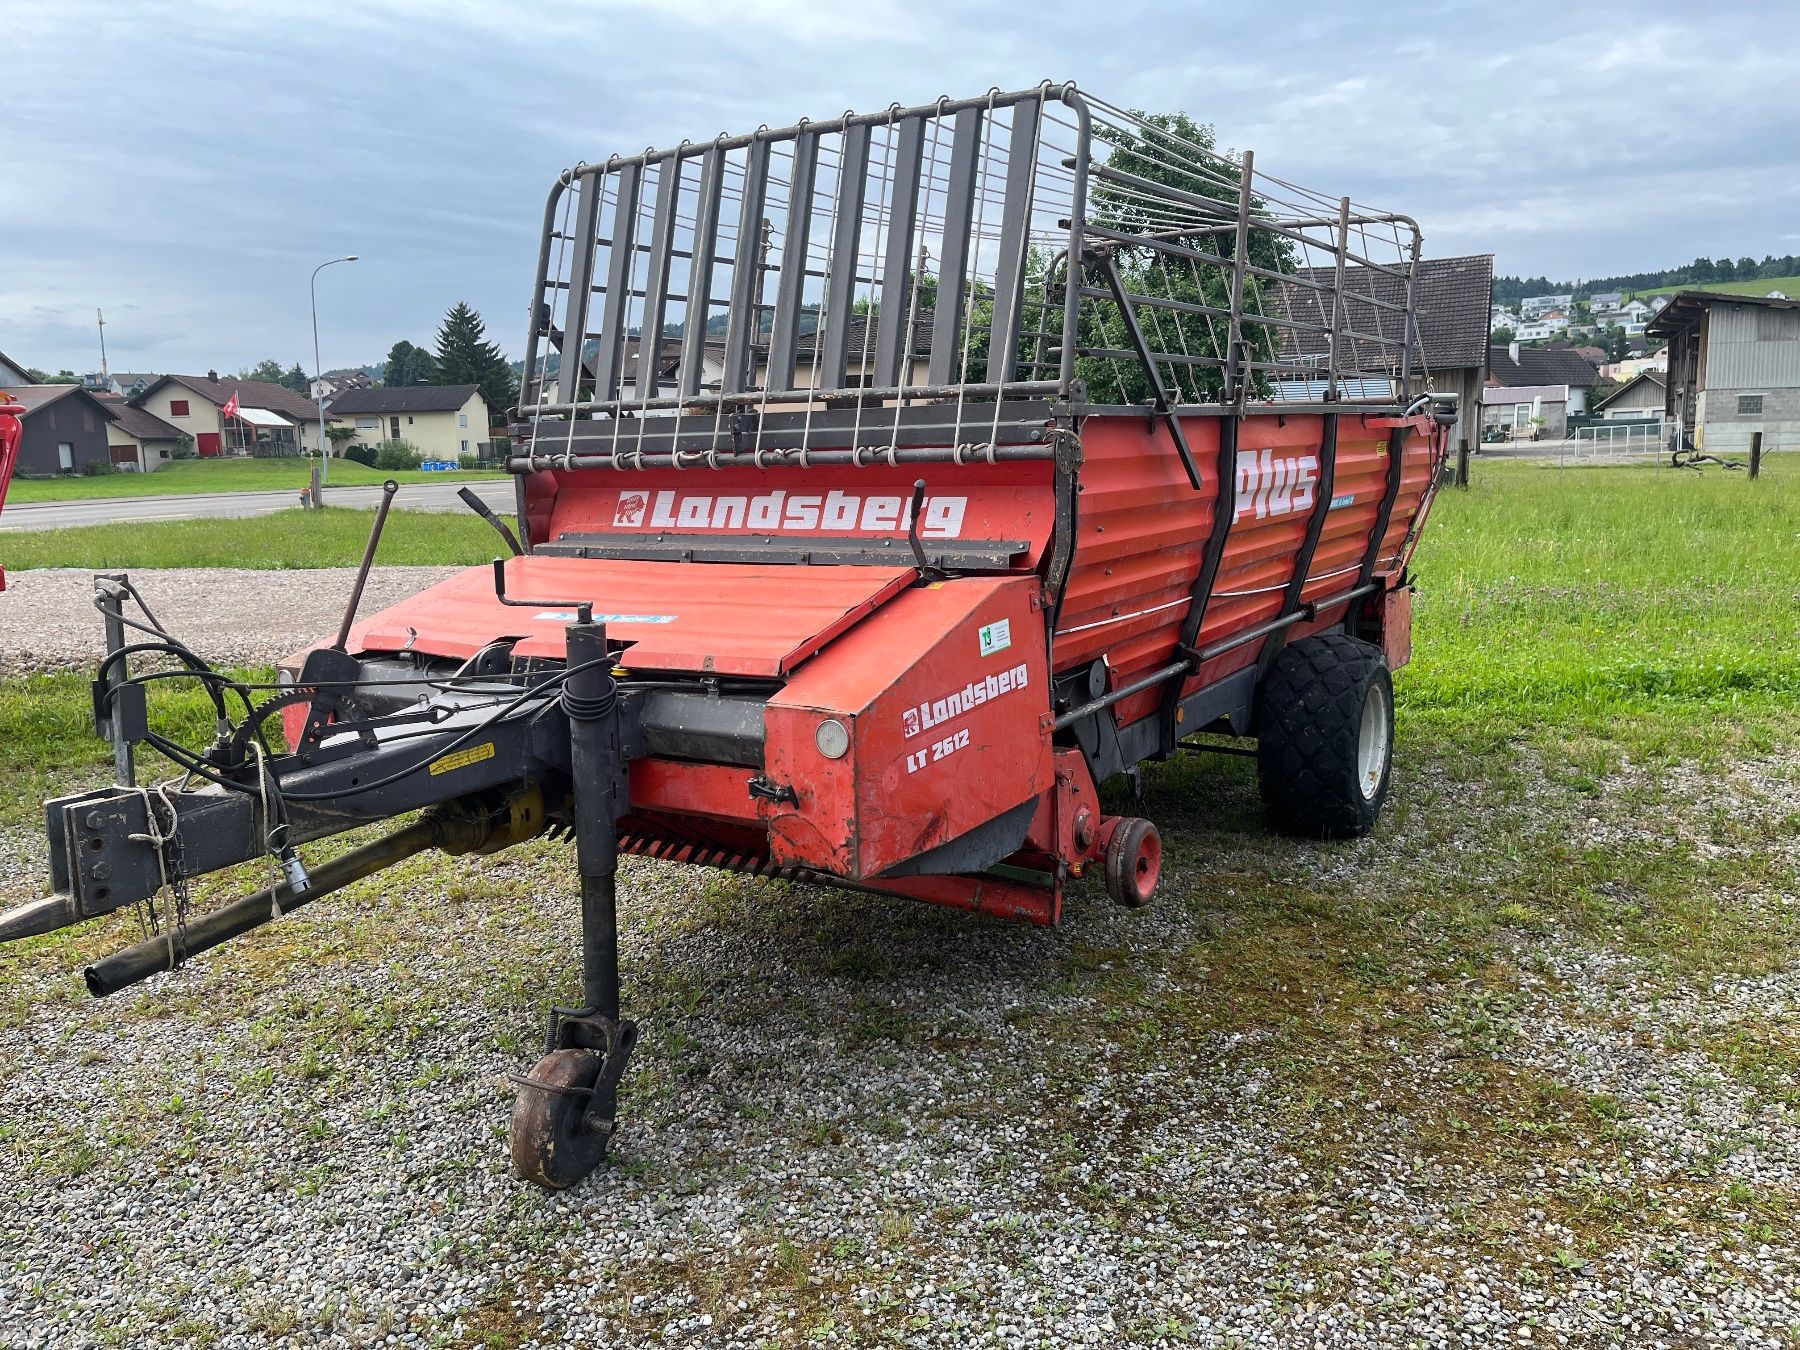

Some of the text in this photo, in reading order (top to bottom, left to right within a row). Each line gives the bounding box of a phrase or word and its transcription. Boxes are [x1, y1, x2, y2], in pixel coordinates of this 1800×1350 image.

[650, 490, 967, 537] Landsberg
[1232, 449, 1317, 524] plus
[920, 664, 1029, 730] Landsberg
[907, 728, 971, 773] LT 2612
